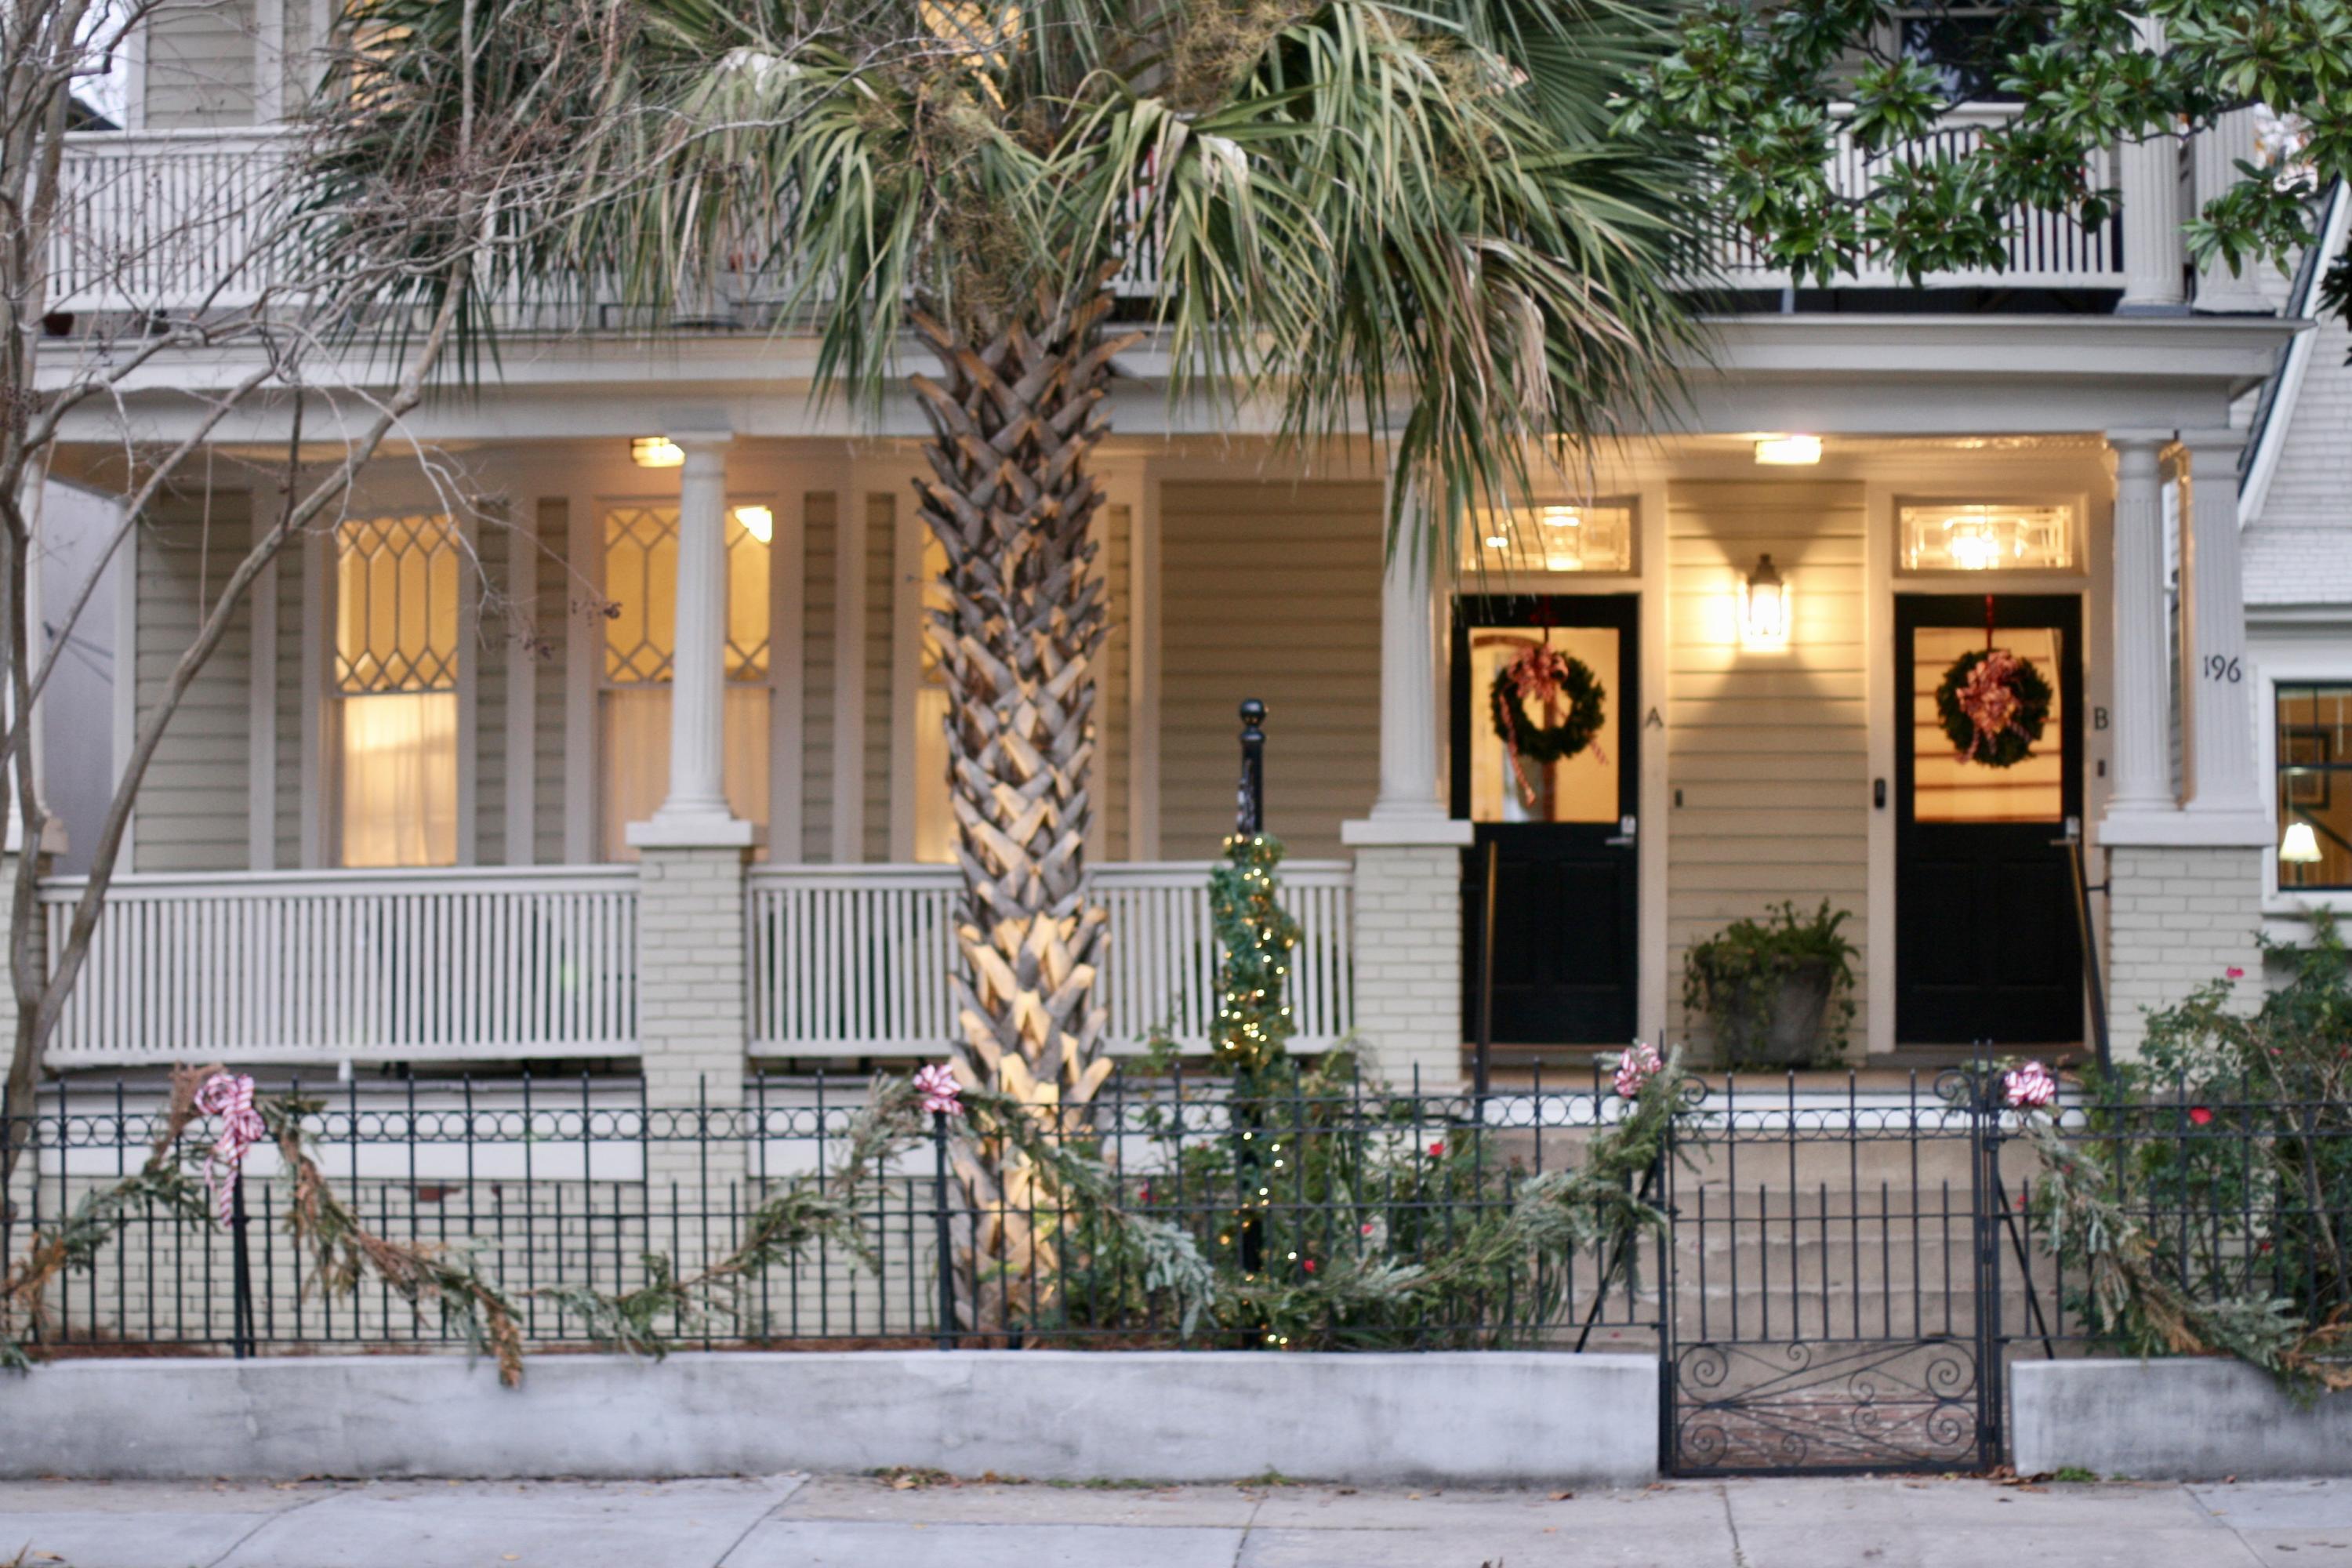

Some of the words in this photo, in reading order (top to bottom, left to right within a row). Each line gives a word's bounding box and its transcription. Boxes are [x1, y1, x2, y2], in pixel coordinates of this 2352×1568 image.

[2204, 654, 2241, 683] 196
[1646, 706, 1664, 728] A
[2094, 706, 2108, 730] B
